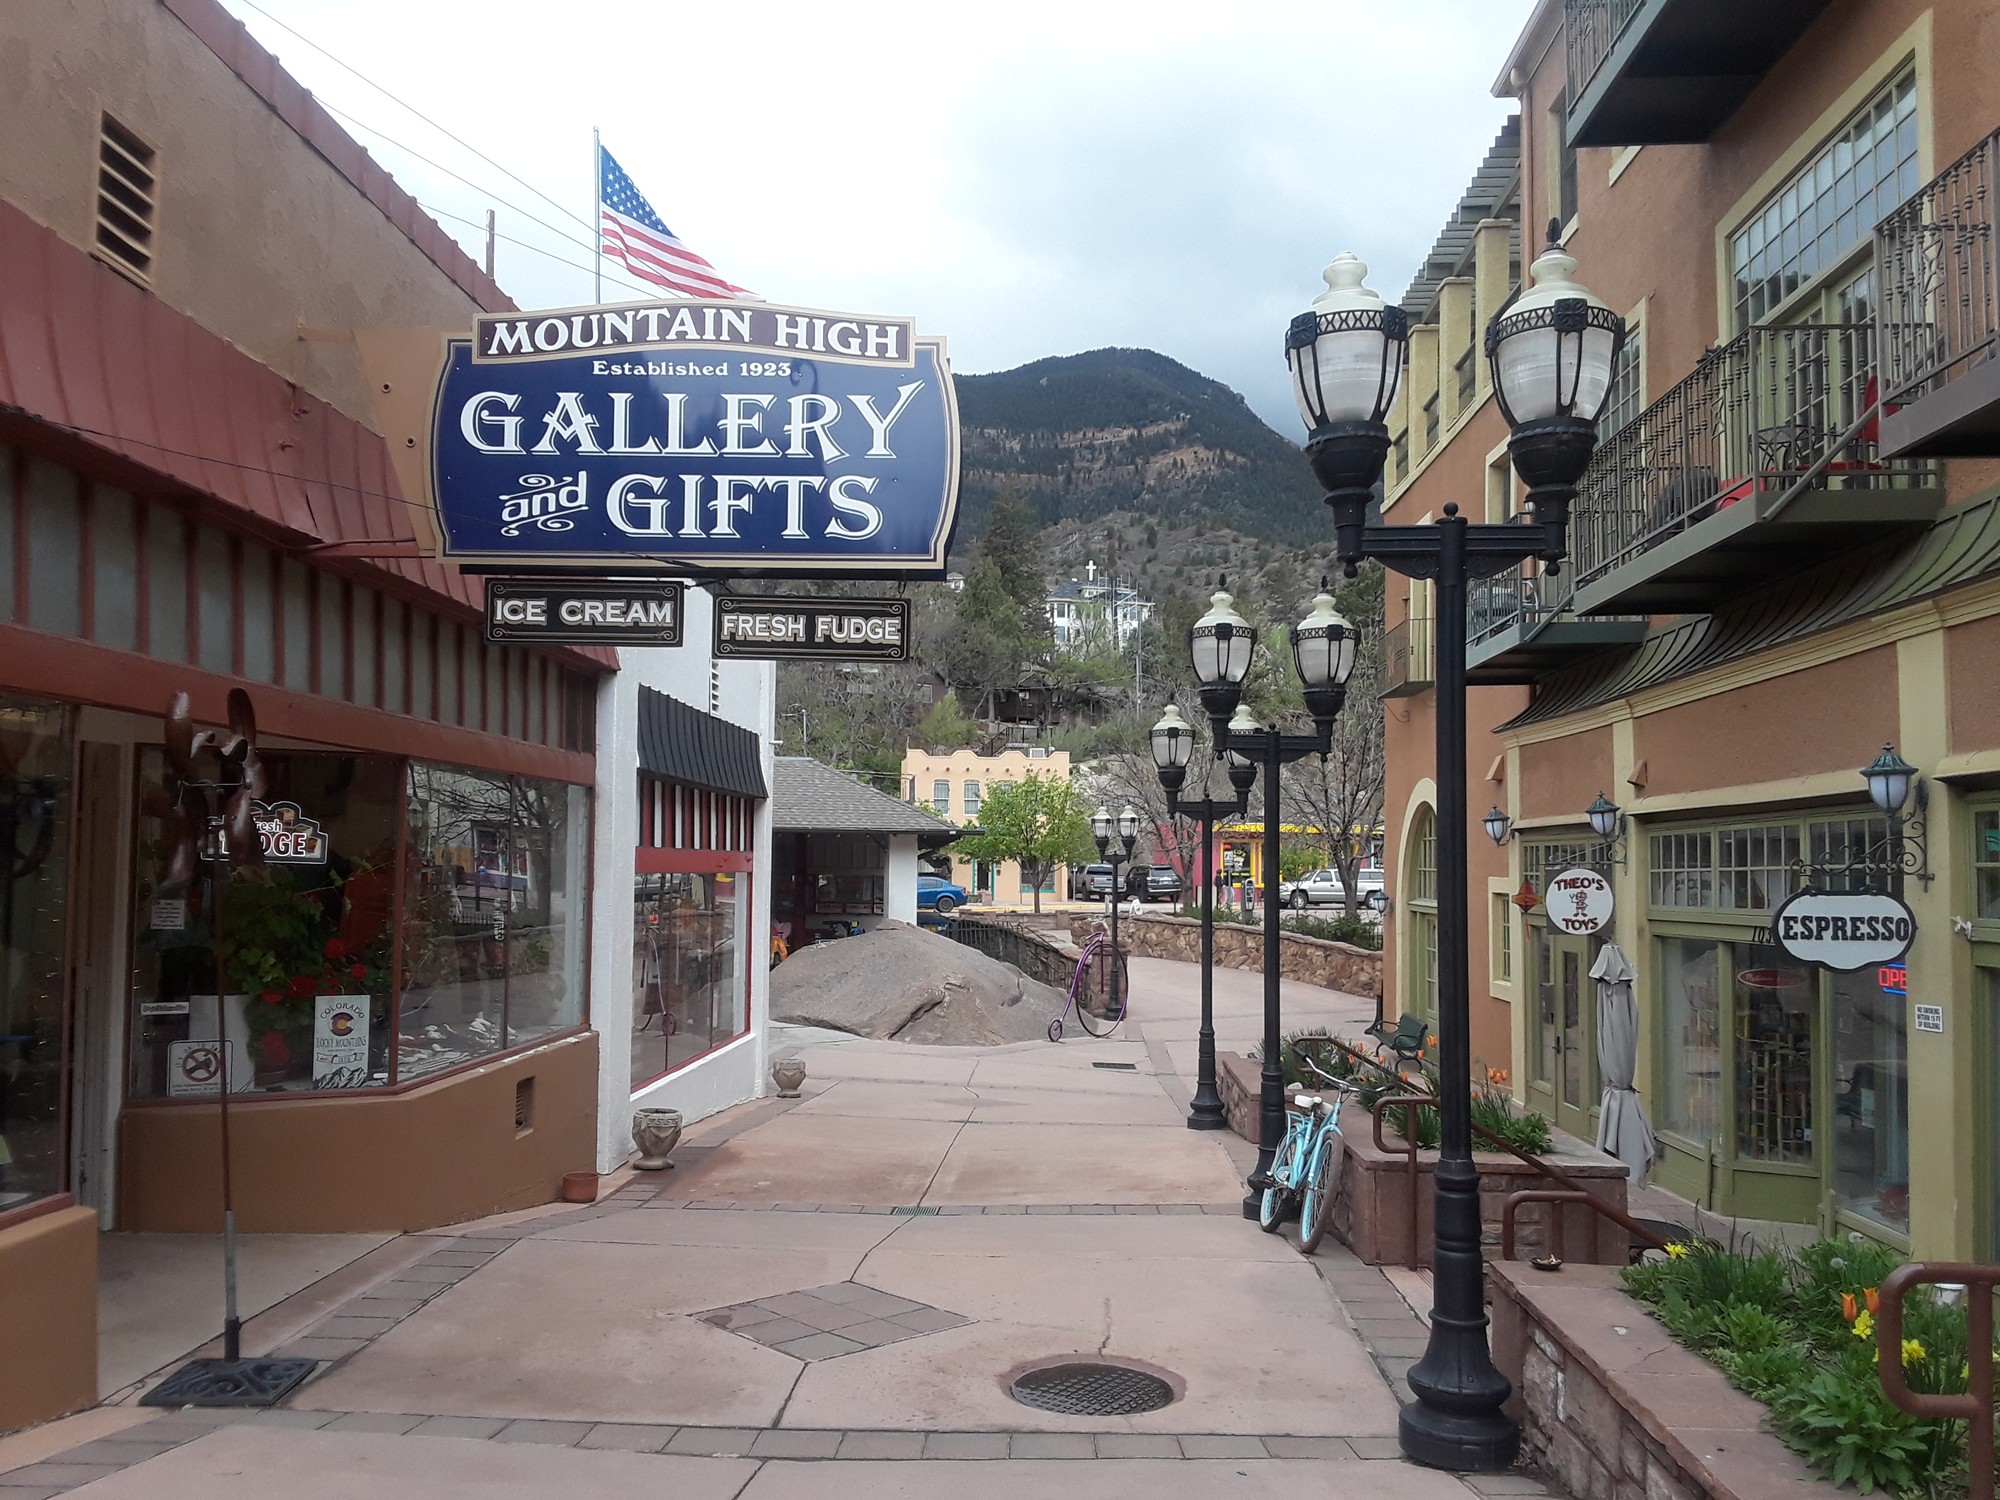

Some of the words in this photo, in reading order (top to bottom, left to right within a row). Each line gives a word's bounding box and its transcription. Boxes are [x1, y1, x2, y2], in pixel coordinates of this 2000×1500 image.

[486, 307, 754, 356] MOUNTAIN
[775, 313, 901, 359] HIGH
[592, 360, 729, 377] Established
[739, 361, 792, 378] 1923
[459, 379, 926, 464] GALLERY
[499, 471, 589, 533] and
[605, 473, 884, 541] GIFTS
[494, 600, 547, 625] ICE
[560, 600, 673, 626] CREAM
[721, 614, 806, 641] FRESH
[814, 616, 902, 643] FUDGE
[253, 818, 283, 833] resh
[1553, 876, 1605, 892] THEO'S
[1561, 917, 1600, 931] TOYS
[1782, 915, 1910, 942] ESPRESSO
[1879, 967, 1908, 989] OPE
[320, 1002, 366, 1019] COLORADO
